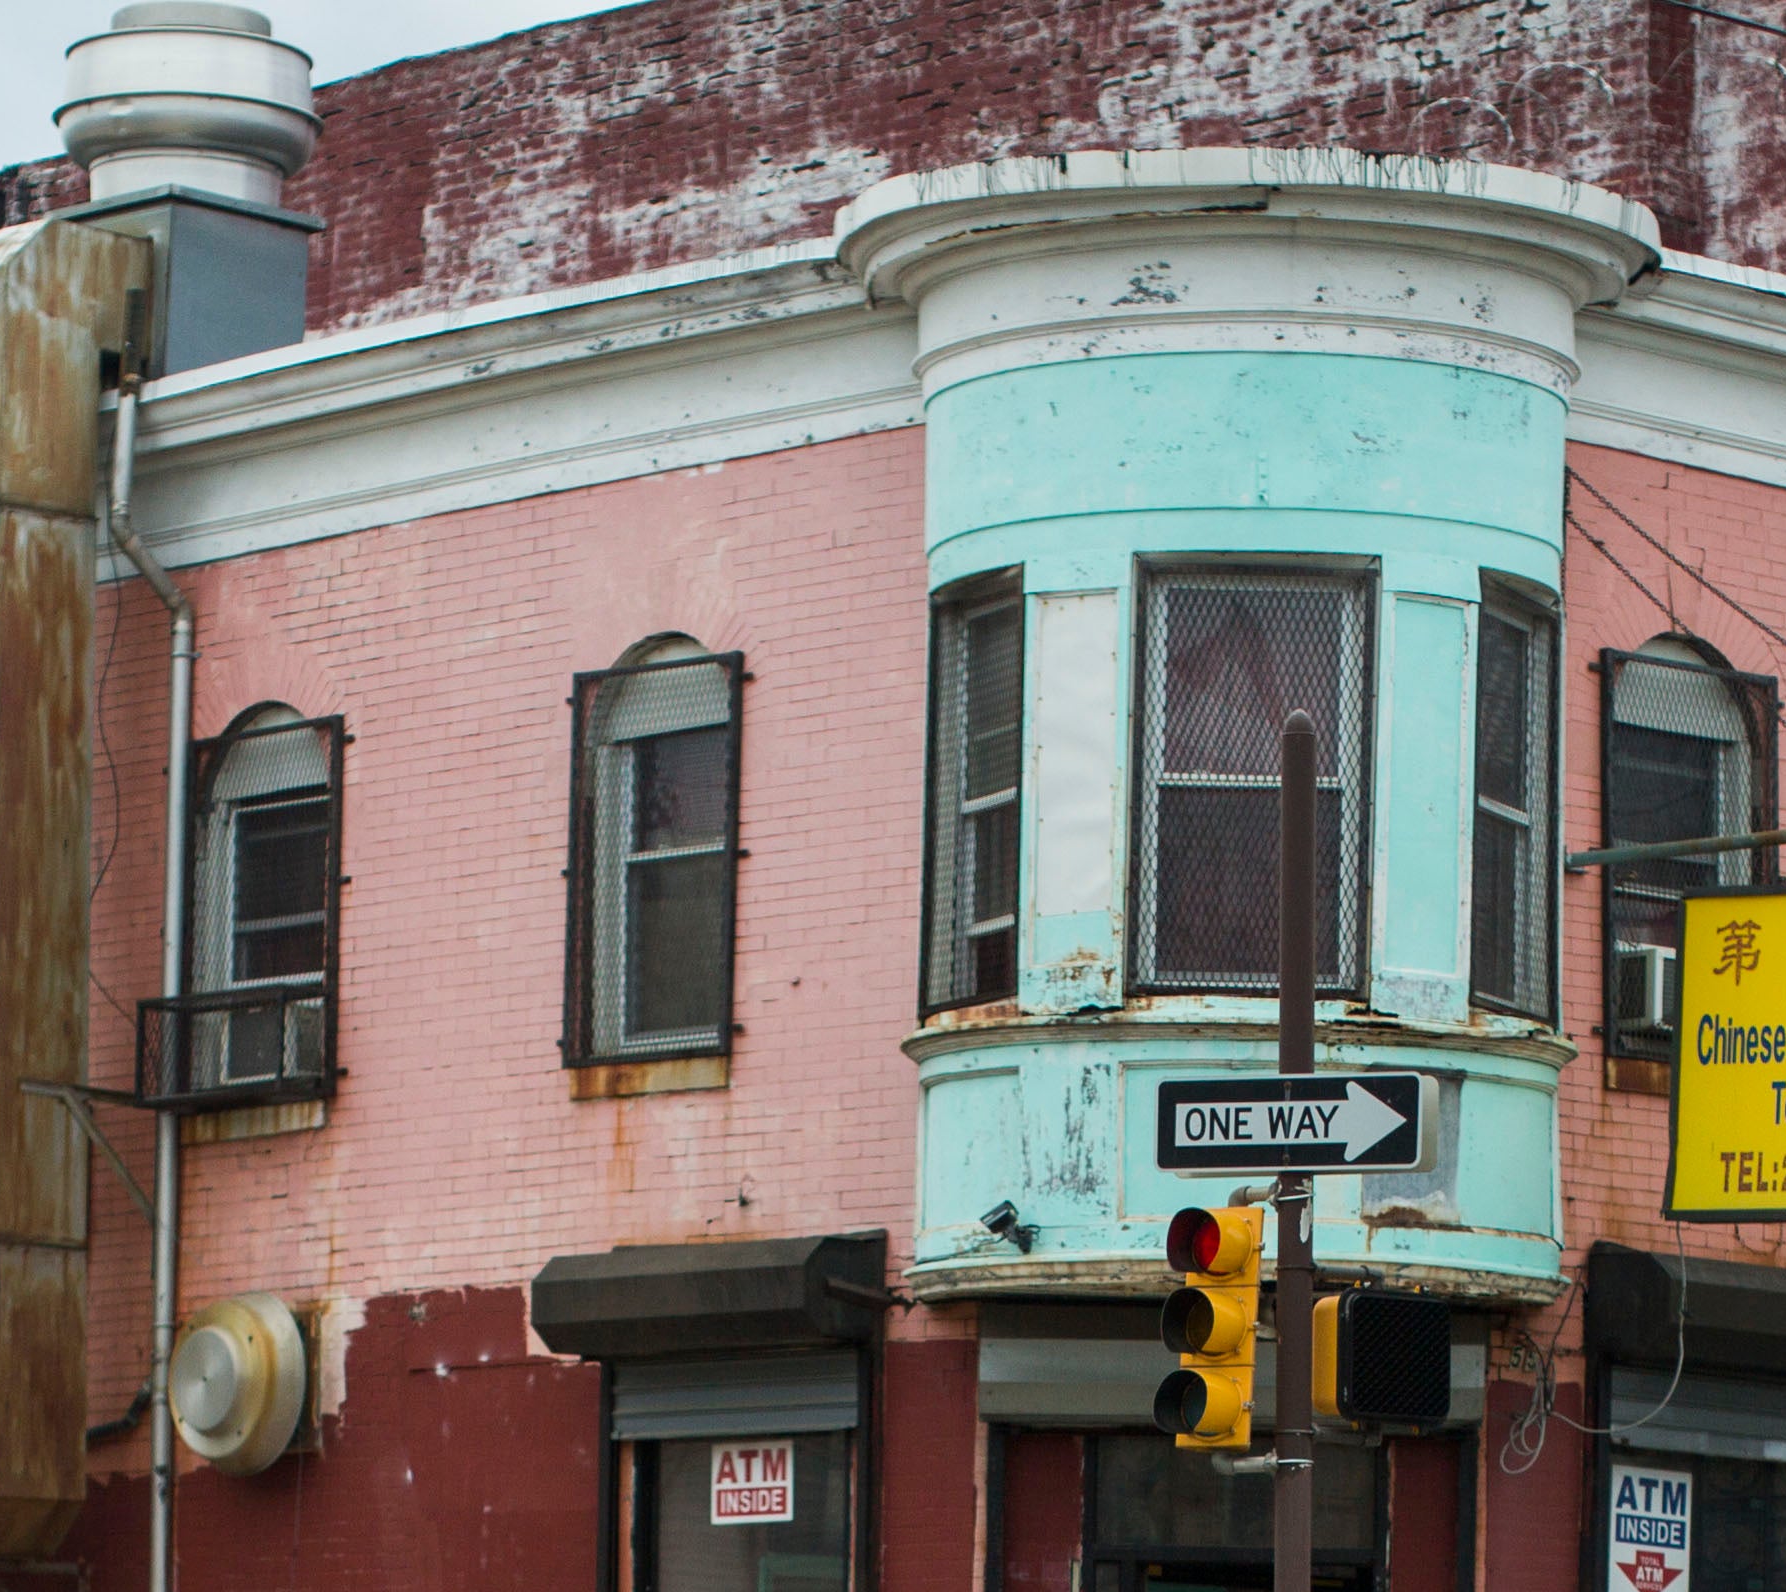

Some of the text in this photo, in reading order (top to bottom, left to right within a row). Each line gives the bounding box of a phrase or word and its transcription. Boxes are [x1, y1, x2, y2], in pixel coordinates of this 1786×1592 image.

[1697, 1013, 1785, 1066] Chinese
[1184, 1104, 1340, 1141] ONE WAY
[716, 1448, 787, 1484] ATM
[720, 1488, 784, 1515] INSIDE
[1616, 1475, 1687, 1517] ATM
[1619, 1516, 1682, 1546] INSIDE
[1636, 1566, 1664, 1583] ATM
[1640, 1556, 1661, 1566] TOTAL
